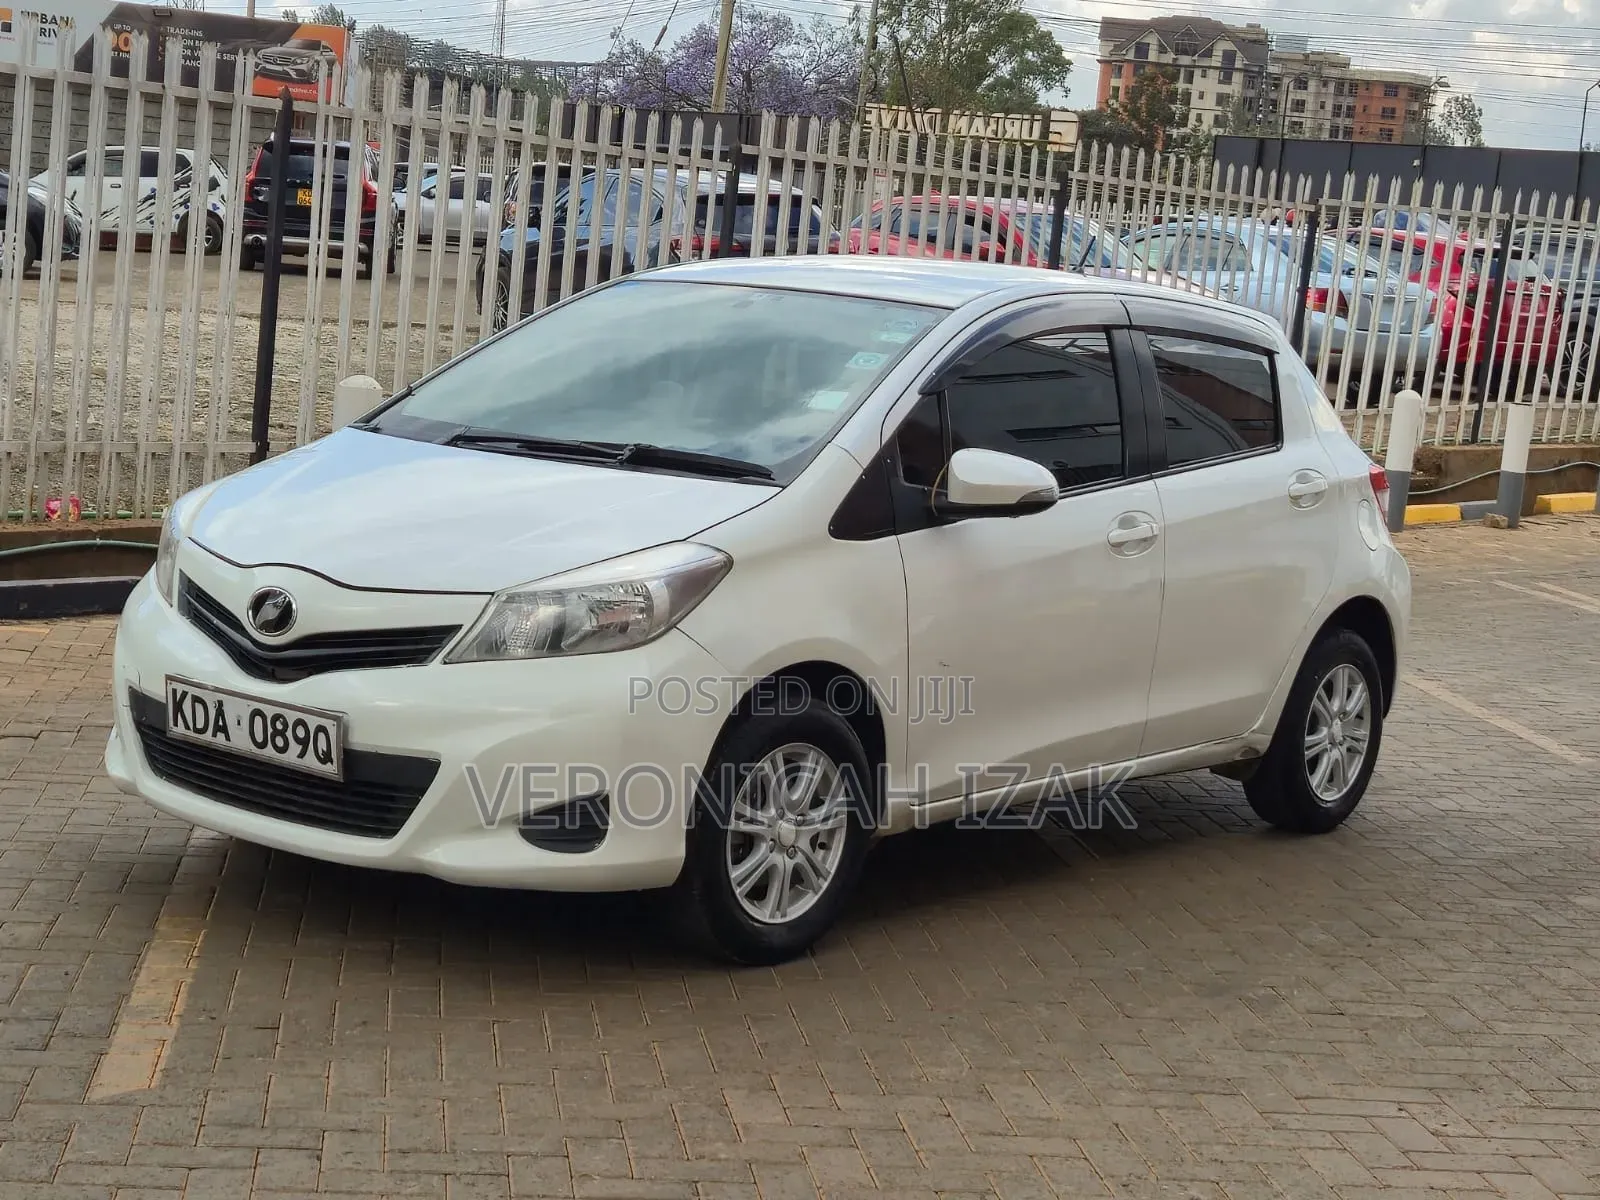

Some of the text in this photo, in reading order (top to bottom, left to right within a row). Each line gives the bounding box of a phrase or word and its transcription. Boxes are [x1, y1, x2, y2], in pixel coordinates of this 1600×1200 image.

[166, 26, 203, 37] TRADE-INS
[171, 687, 334, 766] KDA 089Q
